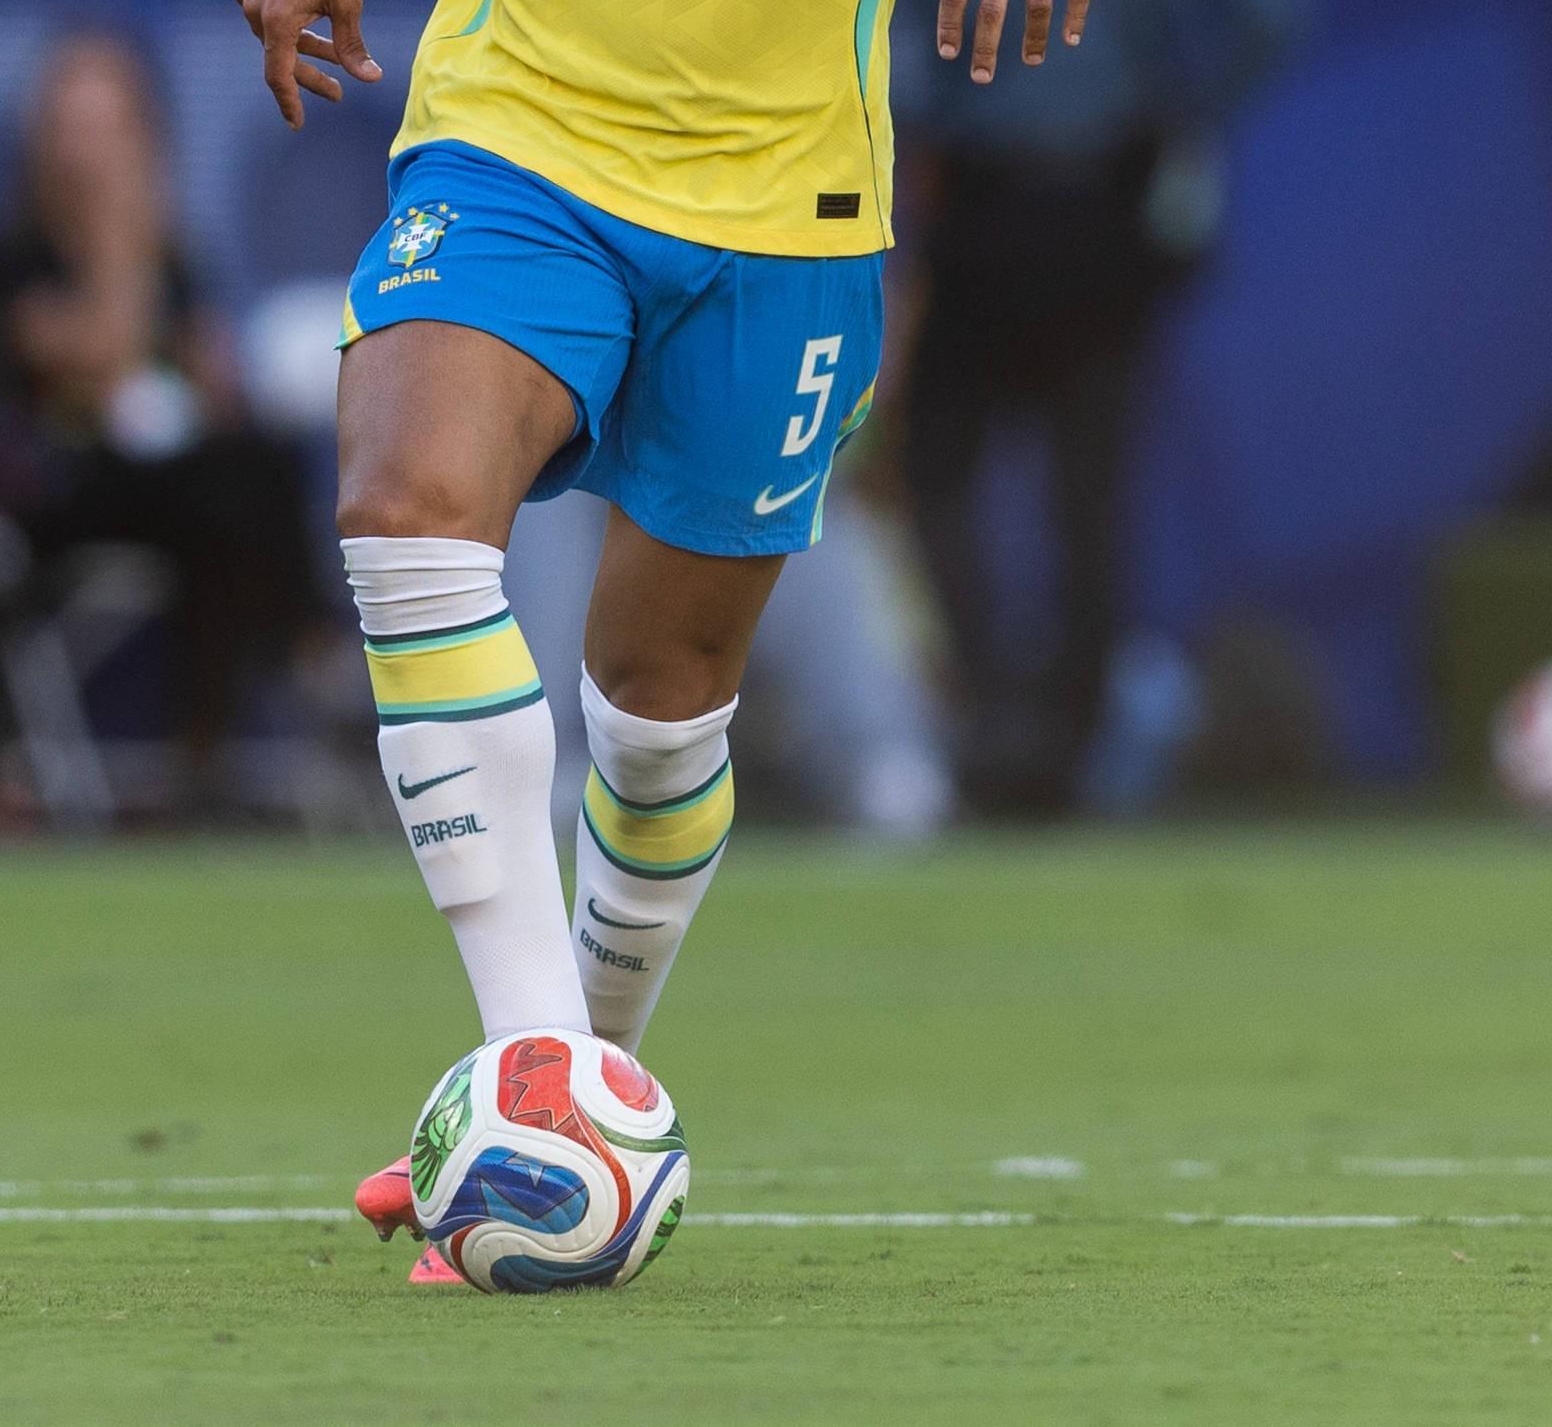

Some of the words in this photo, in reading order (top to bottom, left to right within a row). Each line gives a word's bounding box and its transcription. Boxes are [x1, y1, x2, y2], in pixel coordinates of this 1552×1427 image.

[404, 232, 426, 243] CBF
[378, 268, 441, 294] BRASIL
[780, 334, 843, 457] 5
[411, 813, 487, 847] BRASIL
[579, 929, 649, 972] BRASIL
